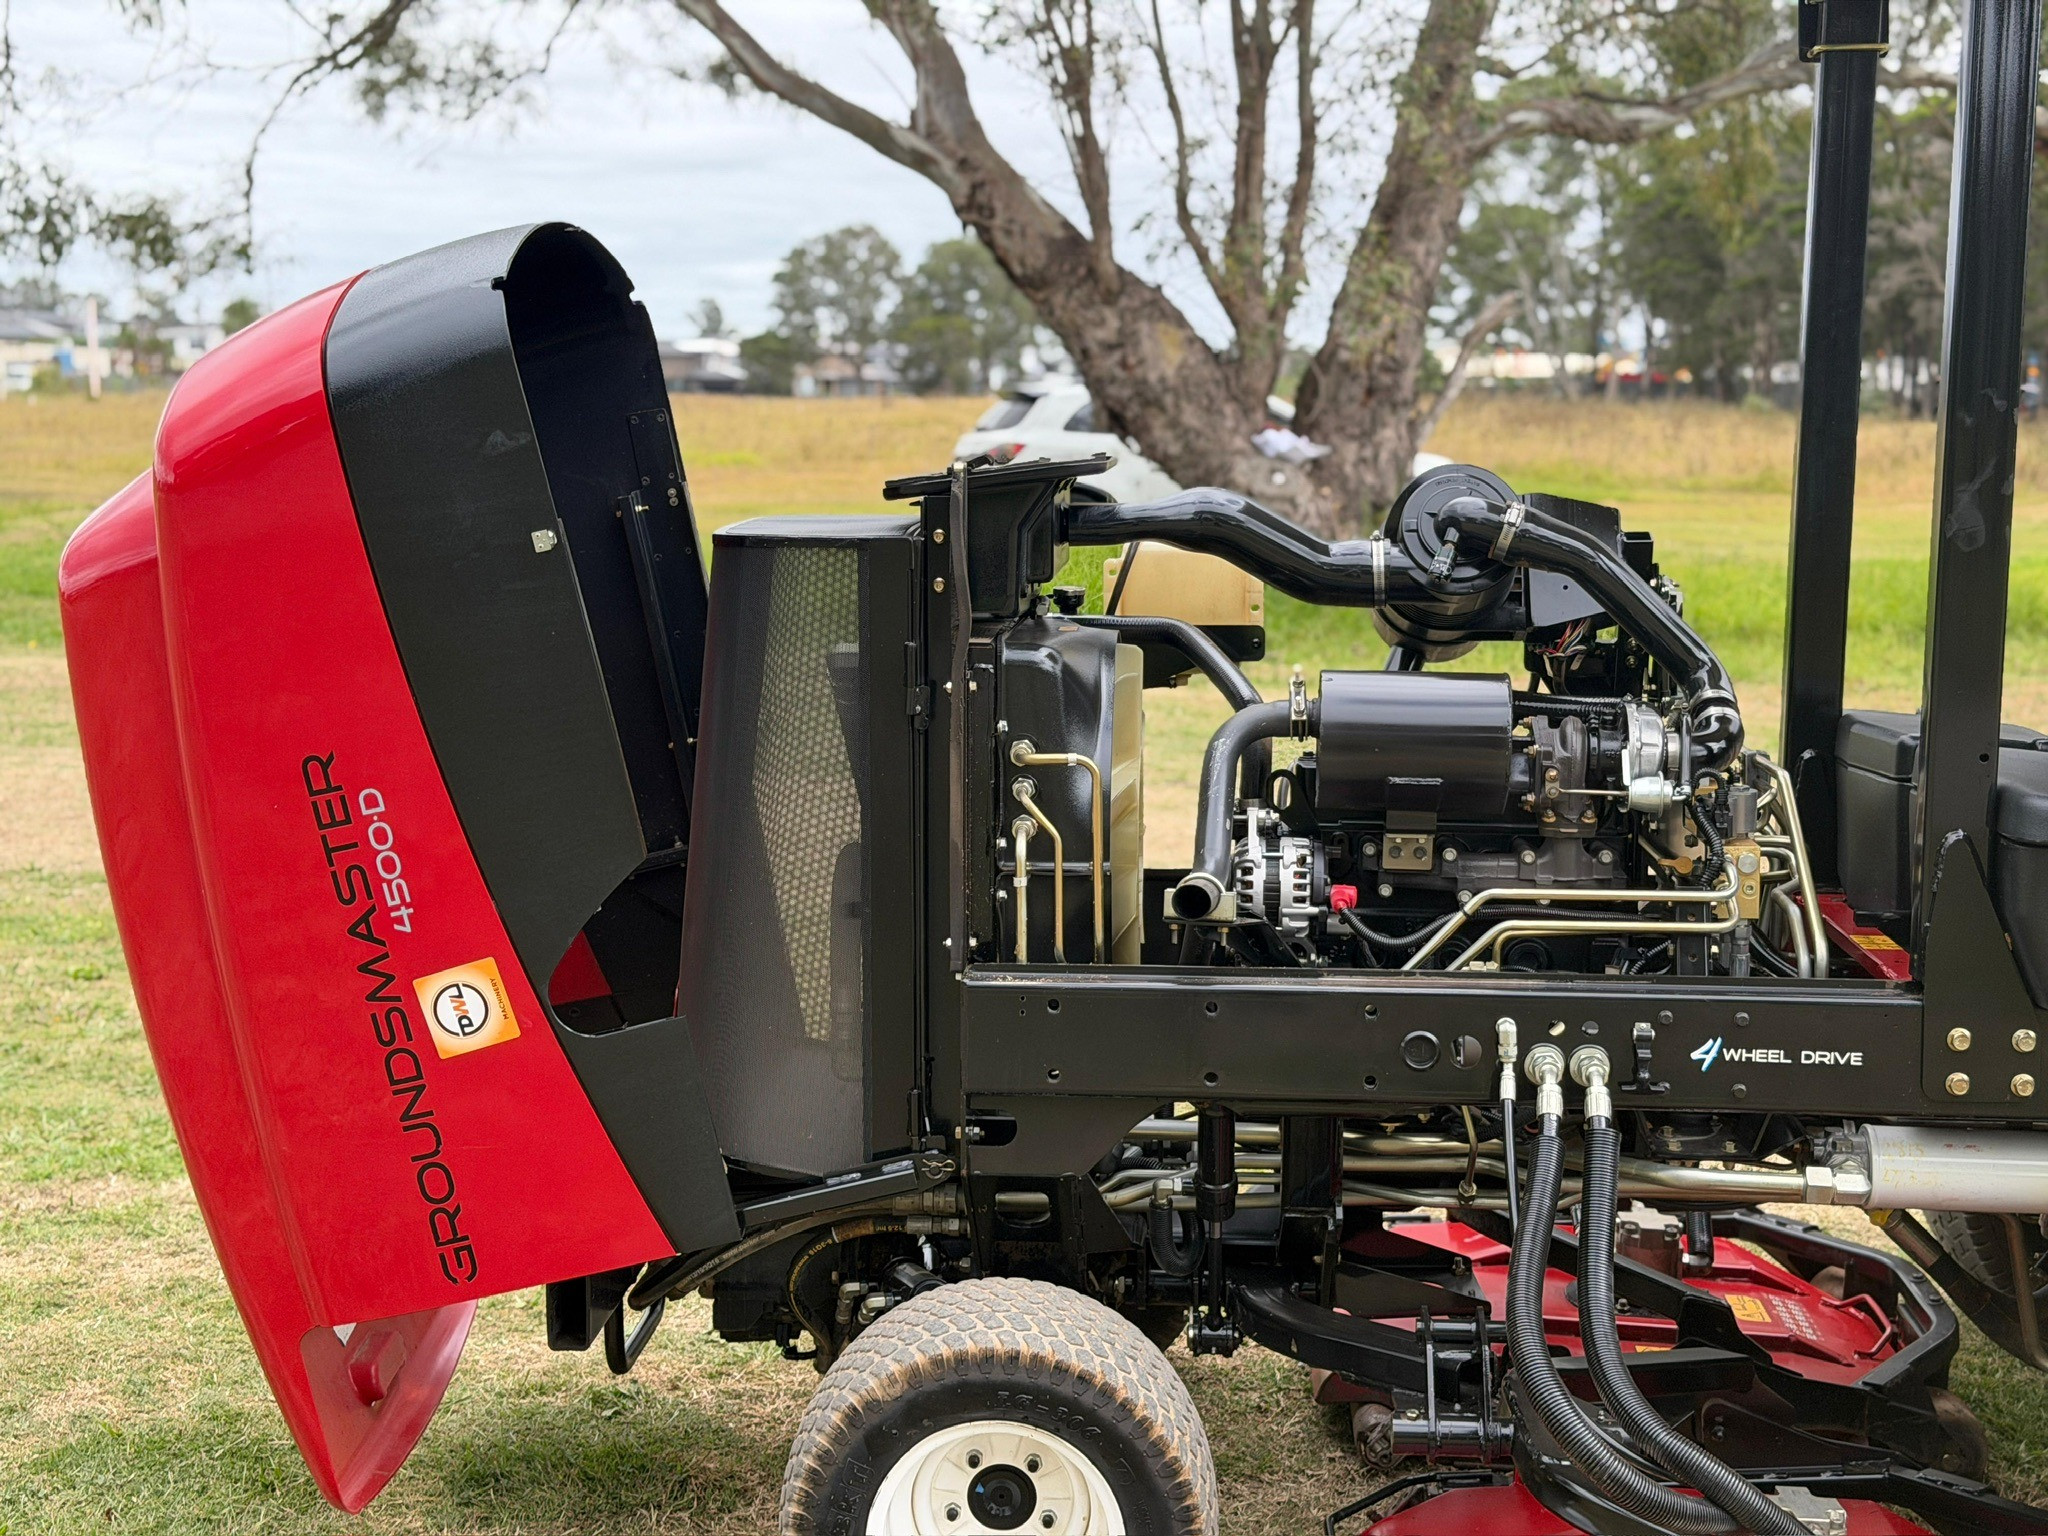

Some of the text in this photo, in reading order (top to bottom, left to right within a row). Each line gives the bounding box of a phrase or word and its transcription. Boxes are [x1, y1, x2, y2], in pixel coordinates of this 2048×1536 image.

[302, 751, 478, 1286] GROUNDSMASTER
[489, 977, 509, 1020] MACHINERY
[1690, 1036, 1864, 1072] 4 WHEEL DRIVE
